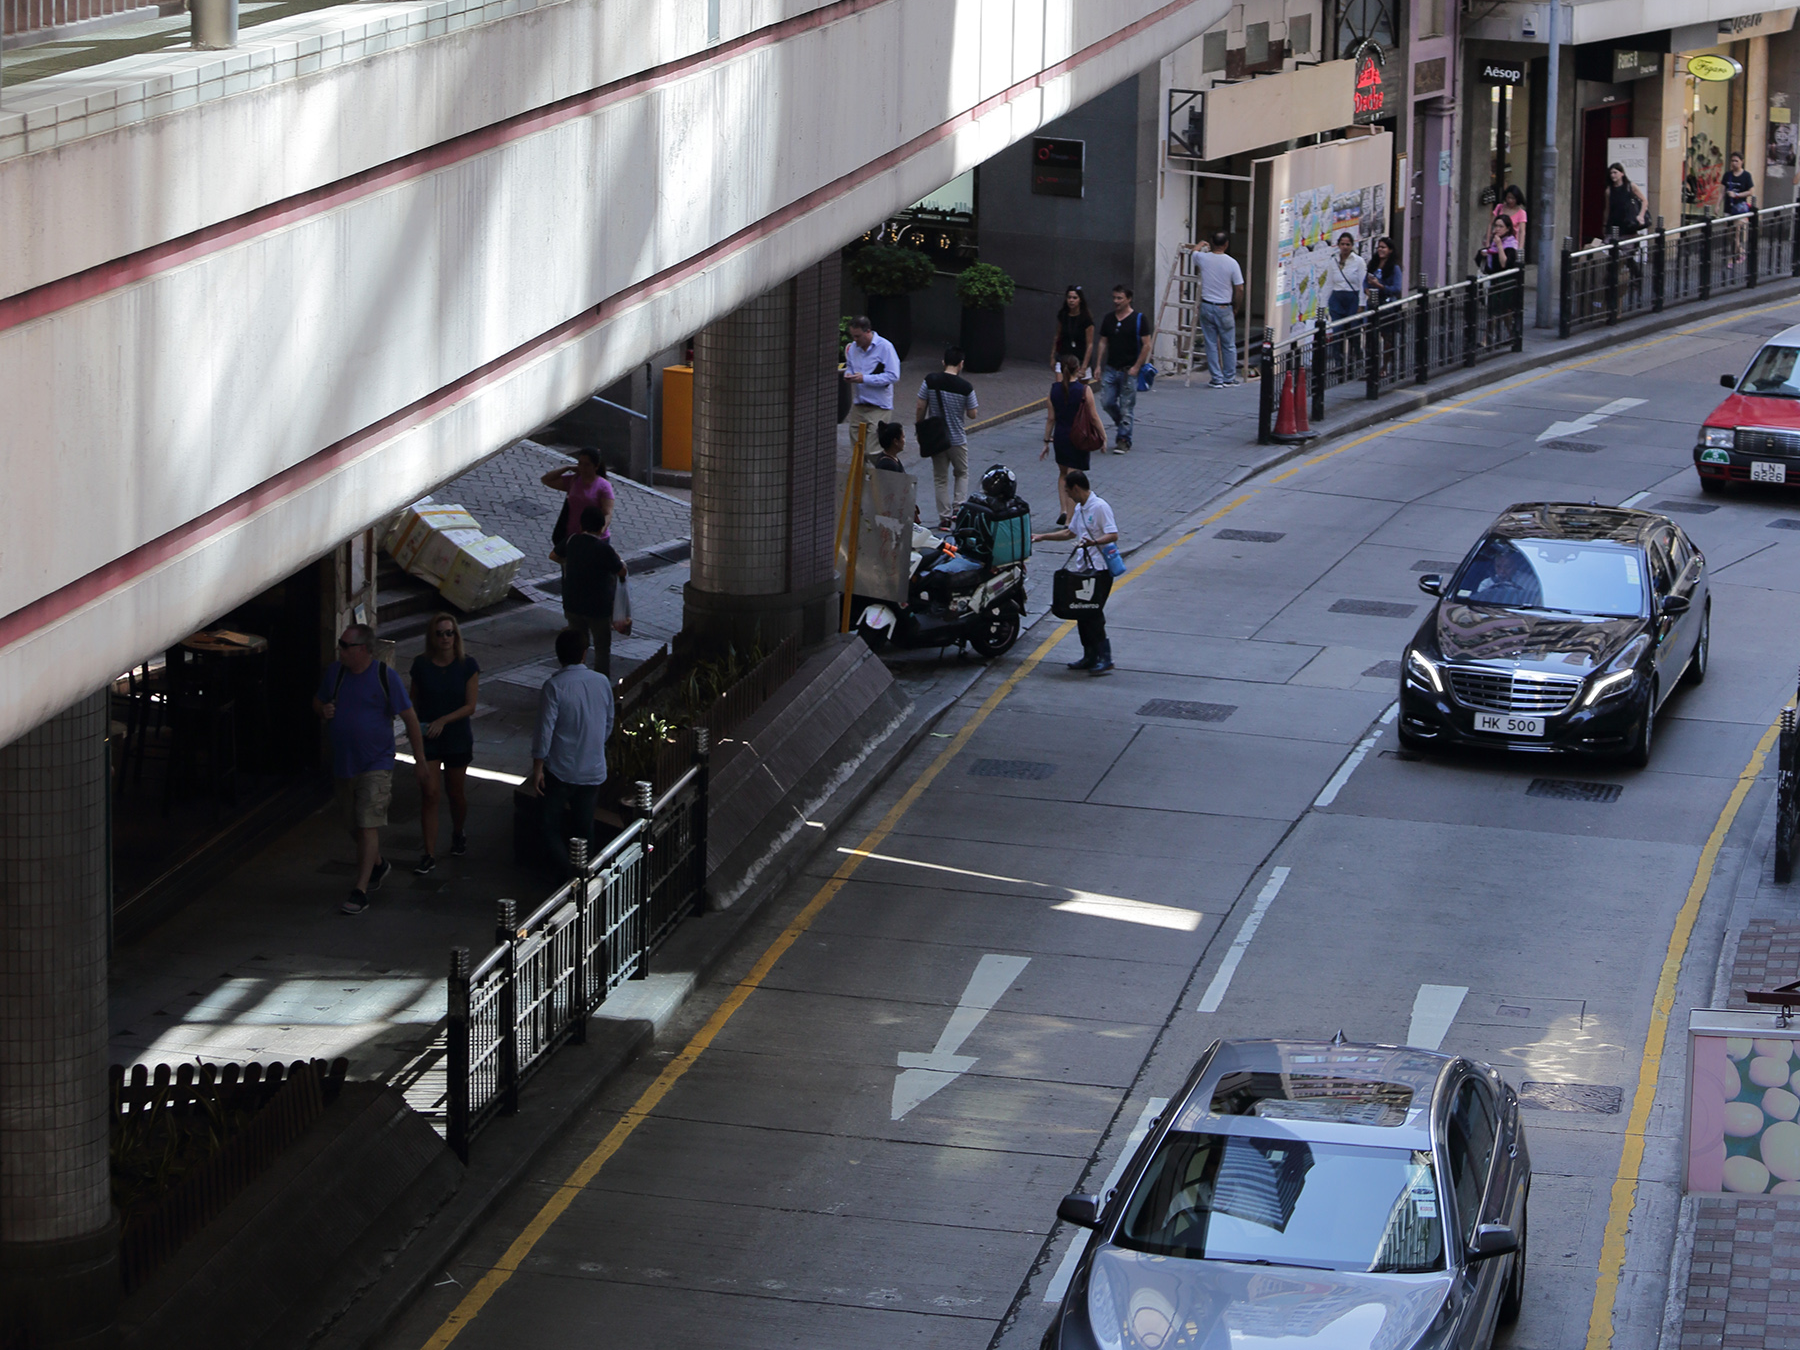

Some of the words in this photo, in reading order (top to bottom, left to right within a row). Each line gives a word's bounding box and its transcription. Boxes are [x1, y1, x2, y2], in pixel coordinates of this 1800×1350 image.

[1694, 59, 1728, 76] Figaro
[1353, 85, 1384, 114] Dacha
[1761, 463, 1776, 473] LN
[1753, 471, 1783, 482] 9226
[1069, 602, 1100, 610] deliveroo
[1482, 716, 1501, 730] HK
[1507, 719, 1537, 733] 500
